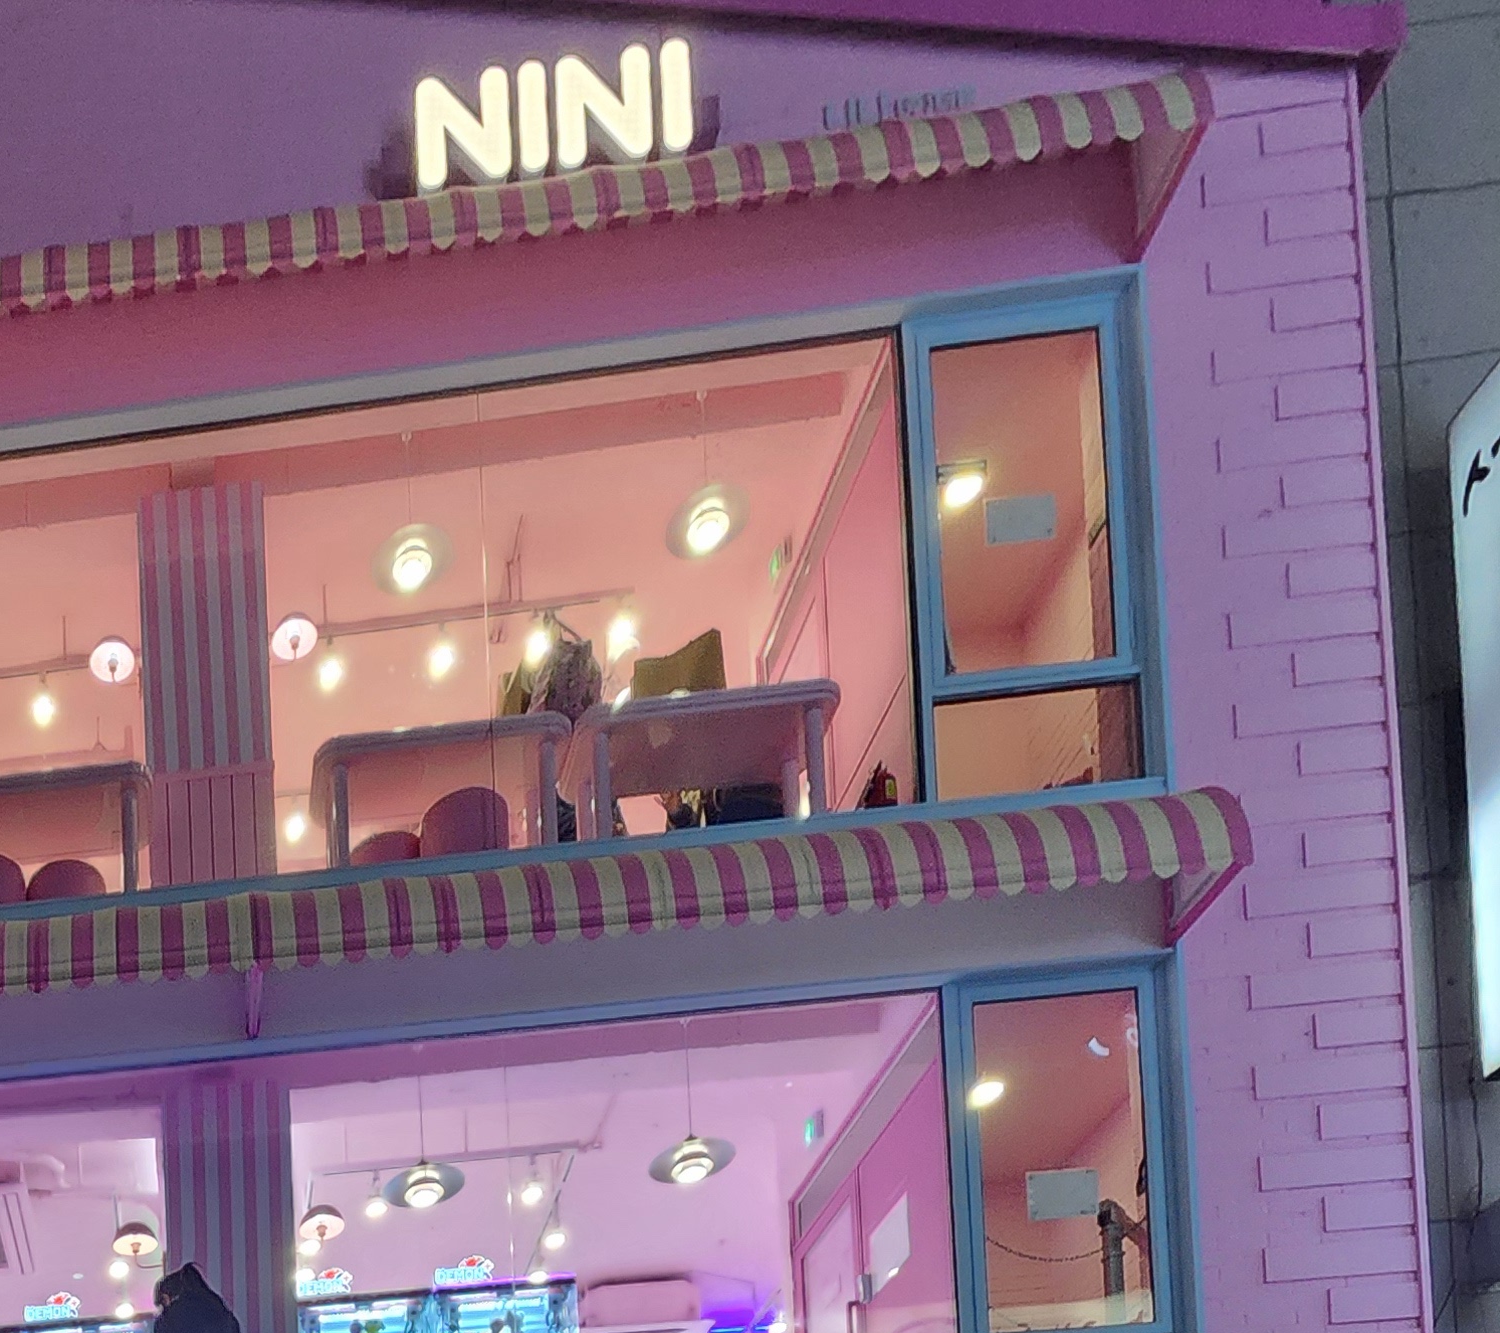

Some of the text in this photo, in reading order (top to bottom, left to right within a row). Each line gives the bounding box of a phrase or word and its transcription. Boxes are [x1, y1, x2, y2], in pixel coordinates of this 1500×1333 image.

[413, 36, 692, 189] NINI
[435, 1267, 484, 1285] DEMON
[24, 1305, 71, 1321] DEMON
